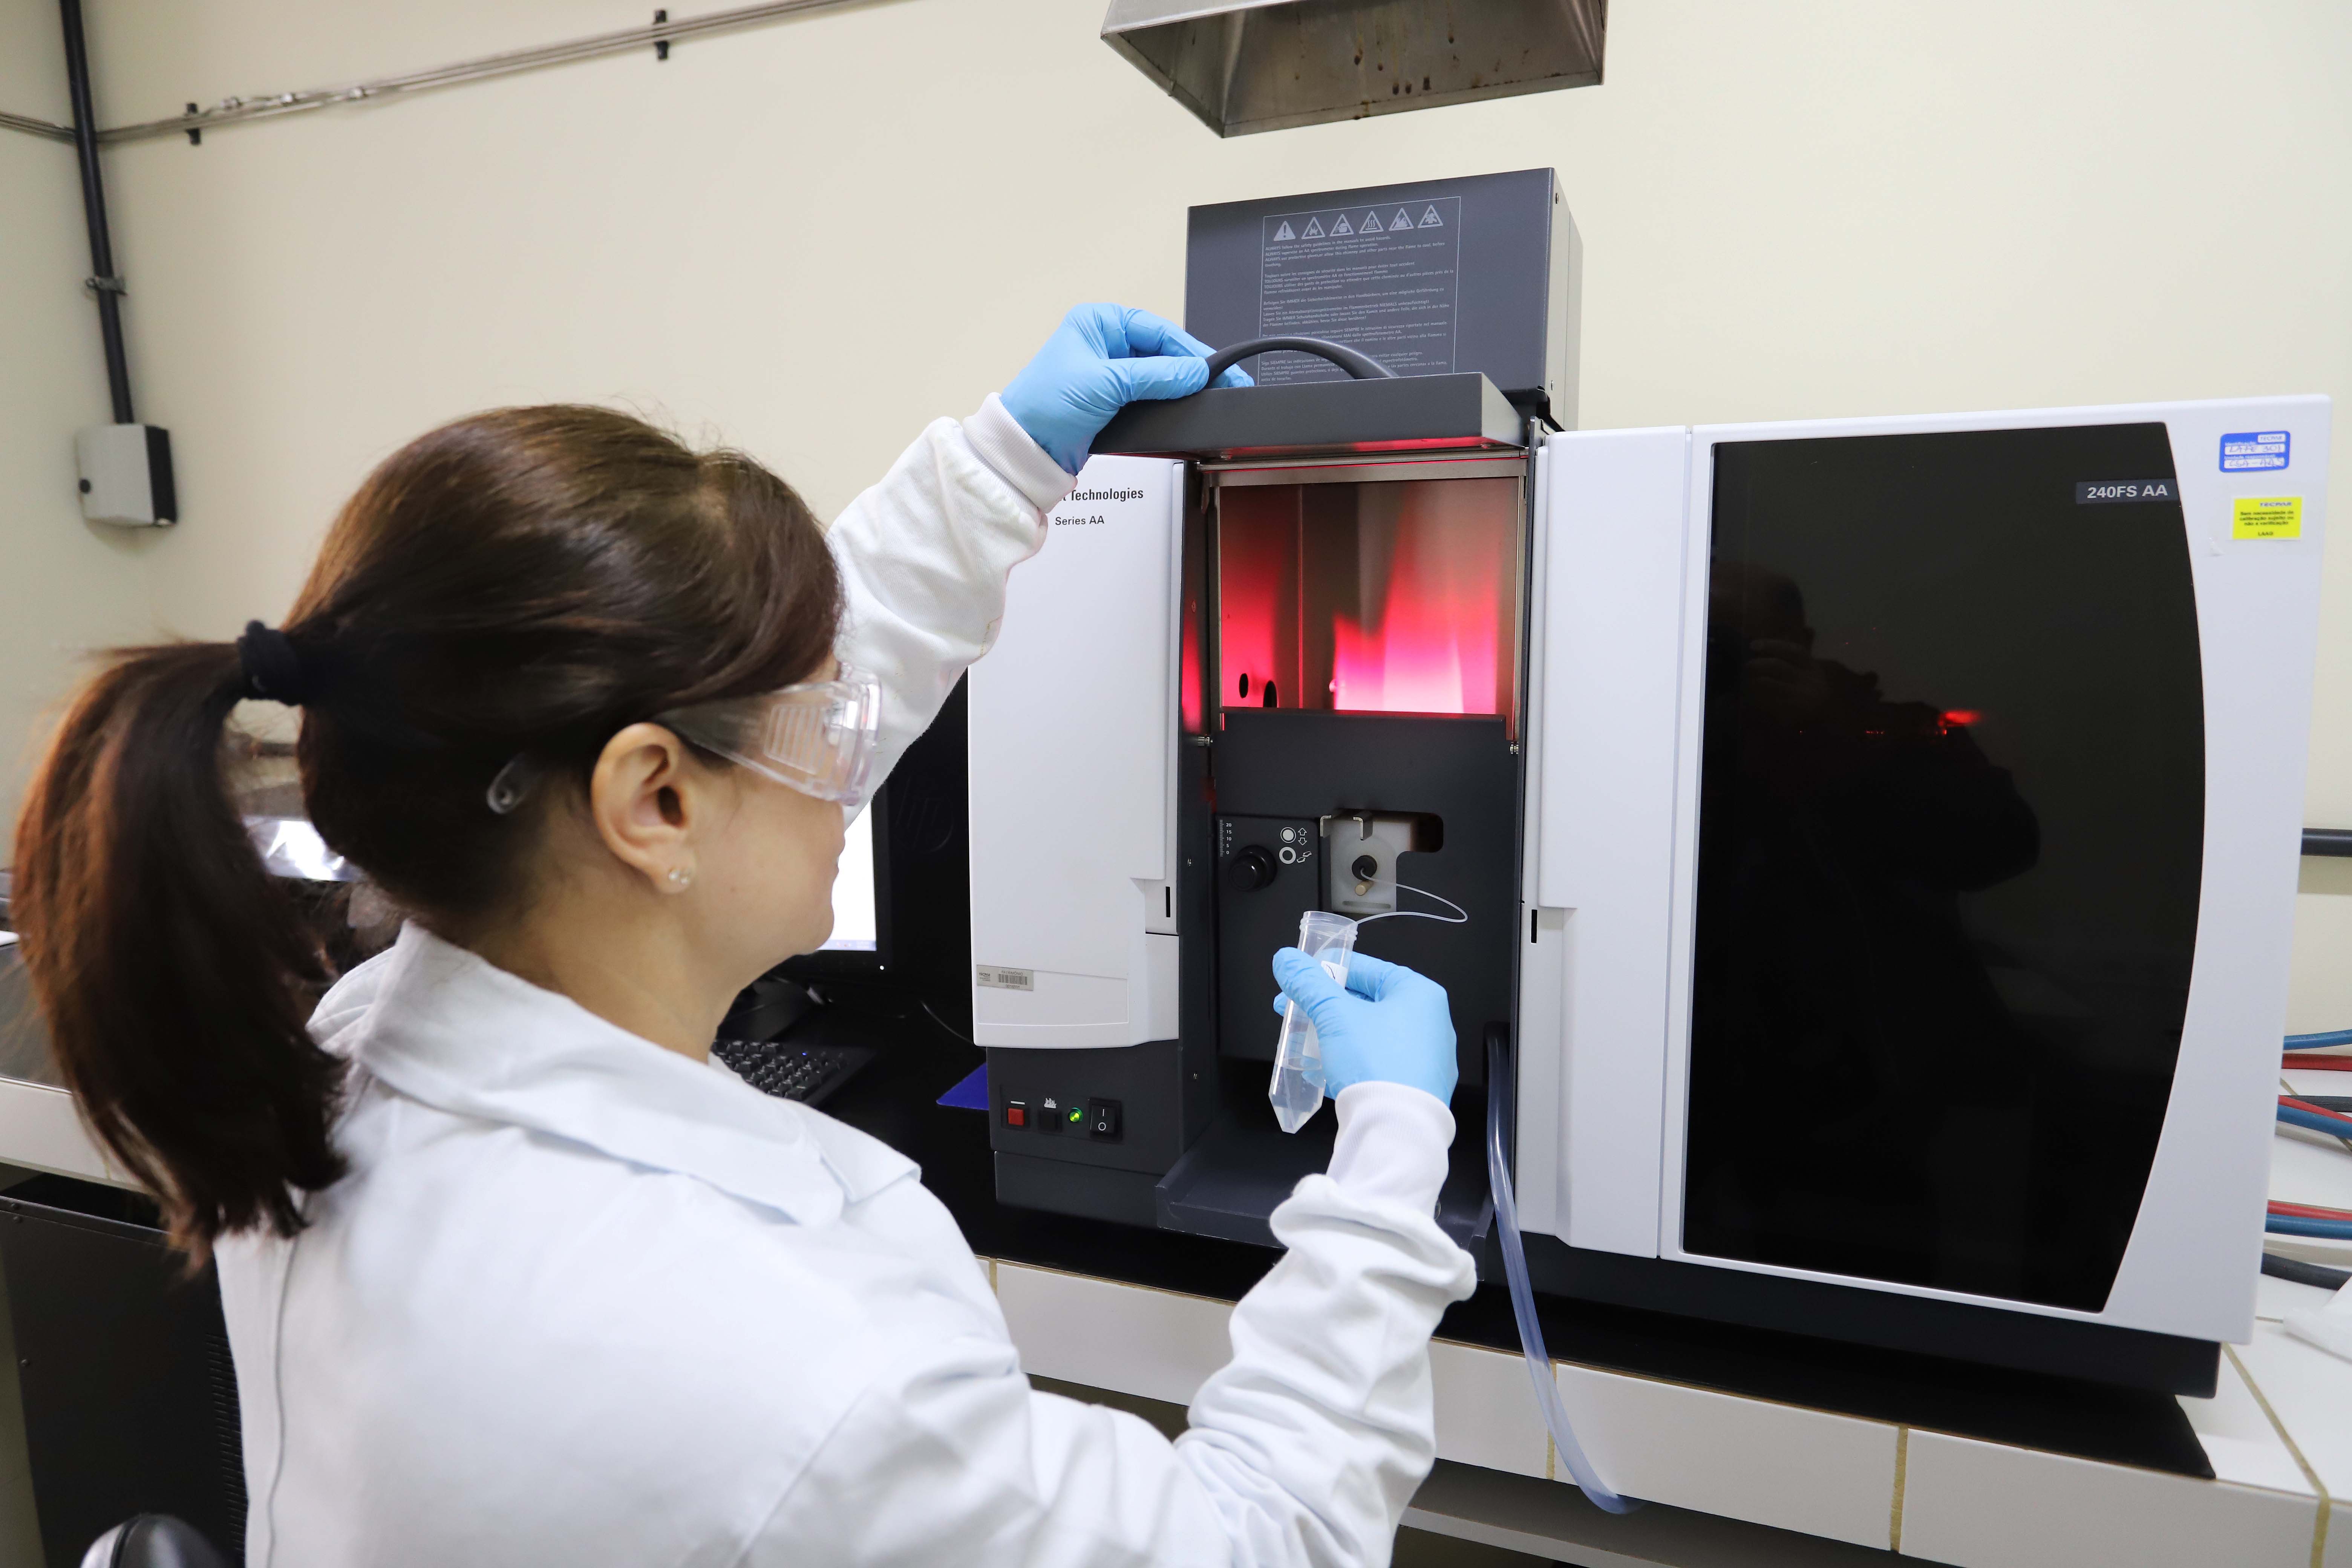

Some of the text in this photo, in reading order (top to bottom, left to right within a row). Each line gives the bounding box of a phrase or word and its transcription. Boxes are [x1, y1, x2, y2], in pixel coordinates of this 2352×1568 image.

[2087, 484, 2168, 499] 240FS AA
[1055, 516, 1105, 525] Series AA
